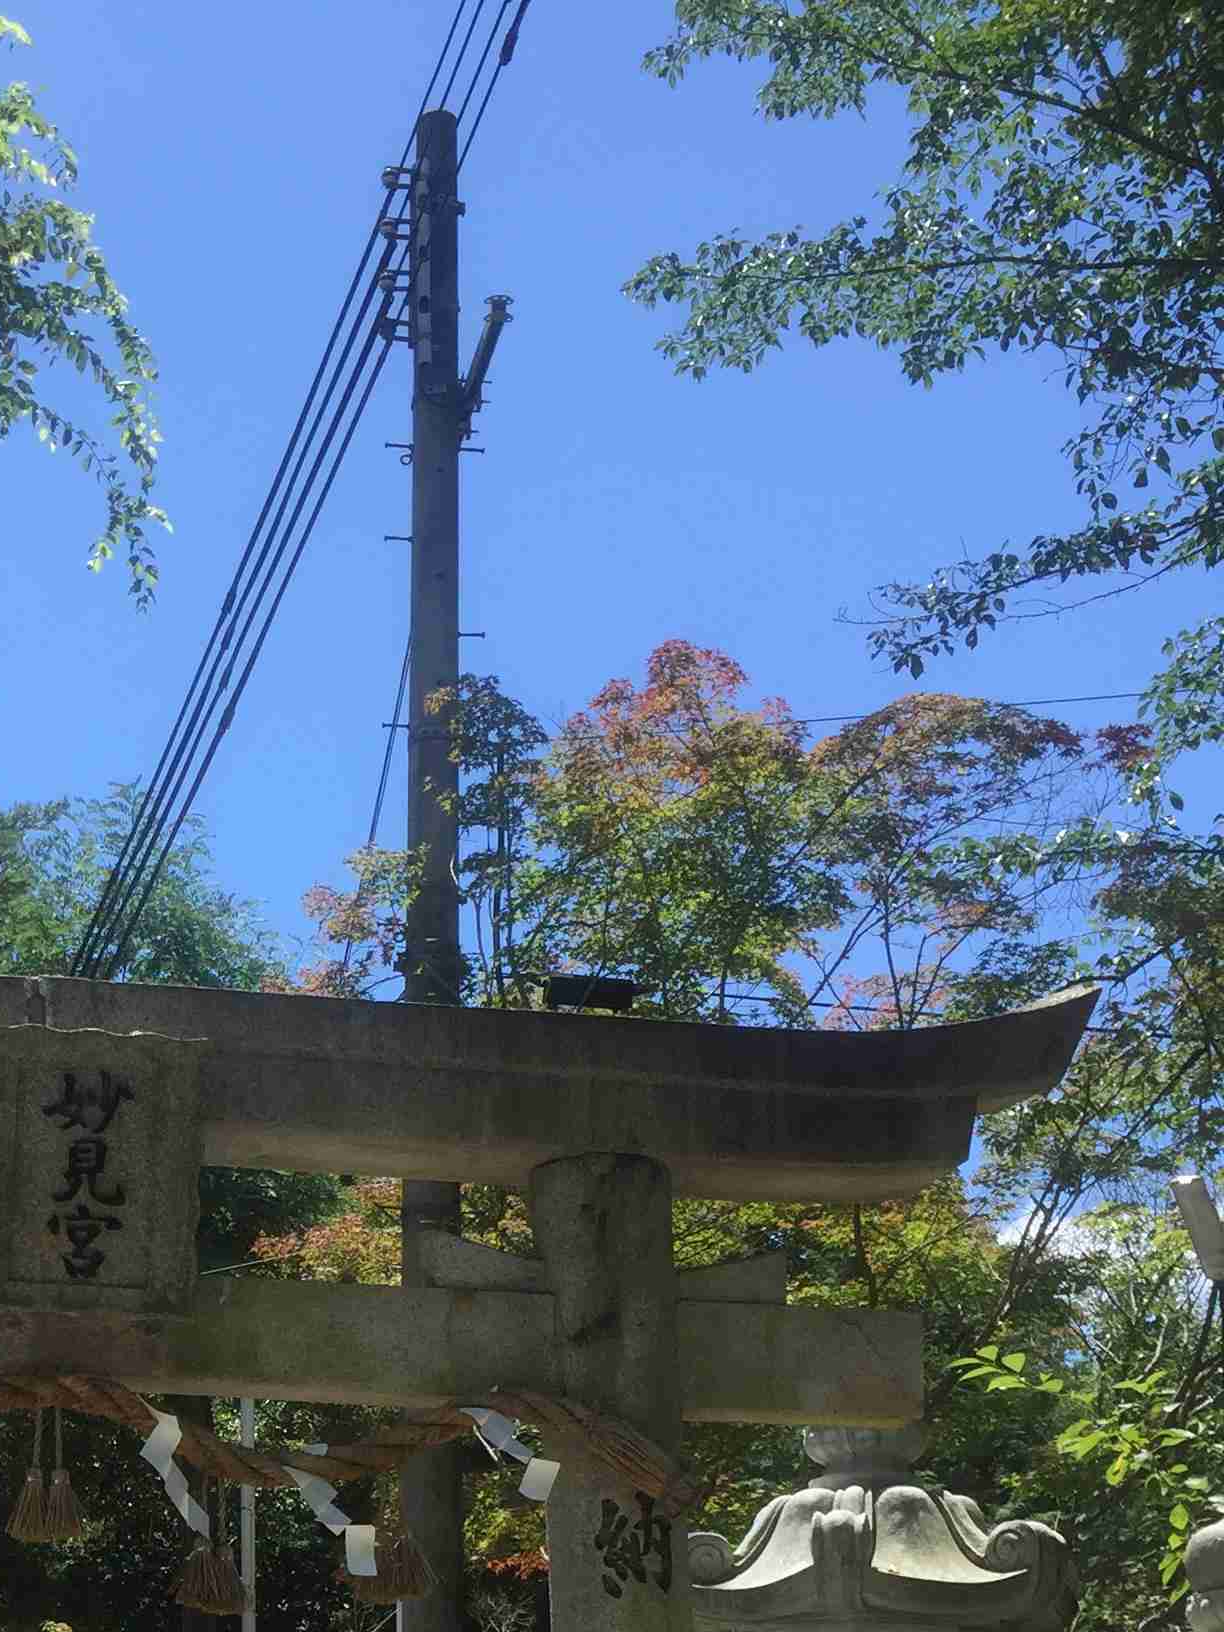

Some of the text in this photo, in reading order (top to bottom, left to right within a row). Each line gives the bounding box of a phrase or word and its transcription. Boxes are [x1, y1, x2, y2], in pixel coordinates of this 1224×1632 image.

[43, 1070, 134, 1278] 妙見宮
[593, 1490, 673, 1599] 納
